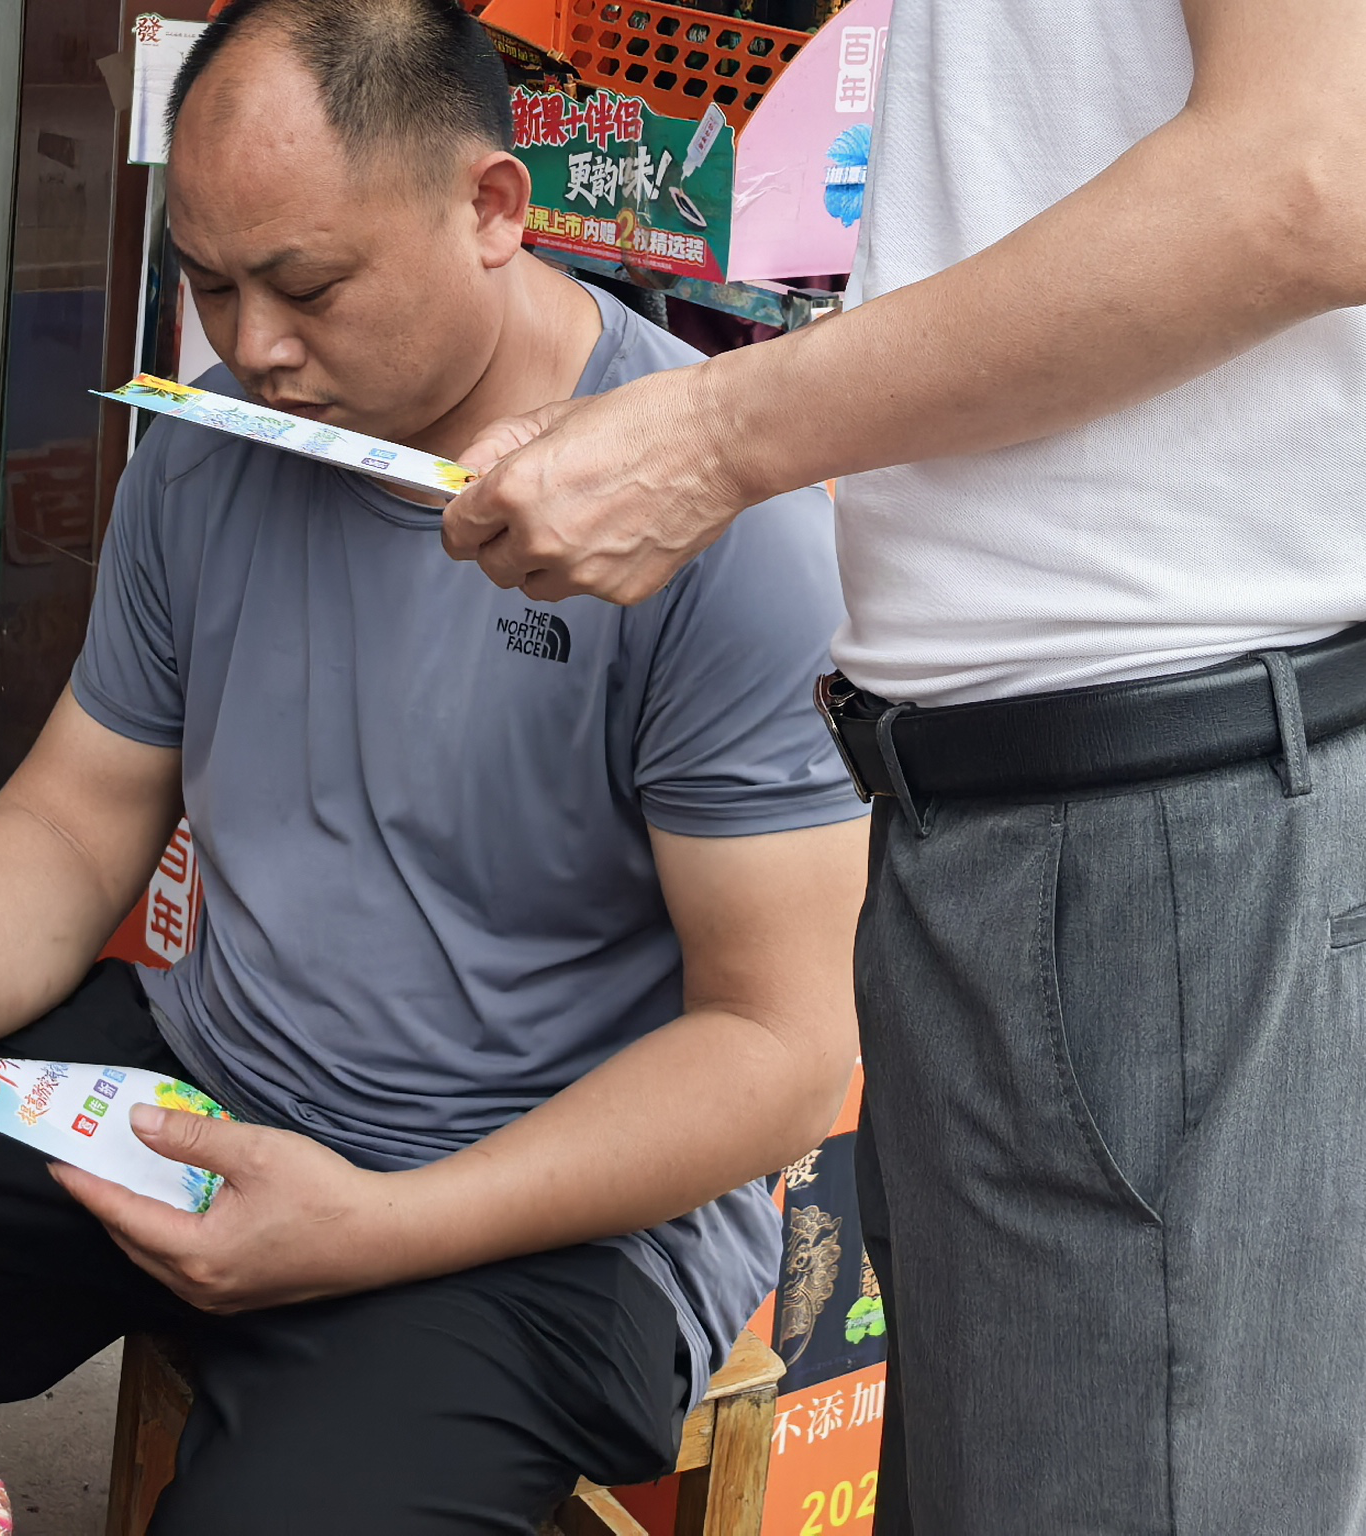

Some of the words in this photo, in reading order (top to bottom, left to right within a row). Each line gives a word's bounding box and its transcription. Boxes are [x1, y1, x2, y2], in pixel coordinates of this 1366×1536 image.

[840, 33, 871, 108] 百年
[496, 617, 545, 642] NORTH
[524, 607, 549, 628] THE
[506, 636, 541, 657] FACE
[772, 1378, 885, 1456] 不添加
